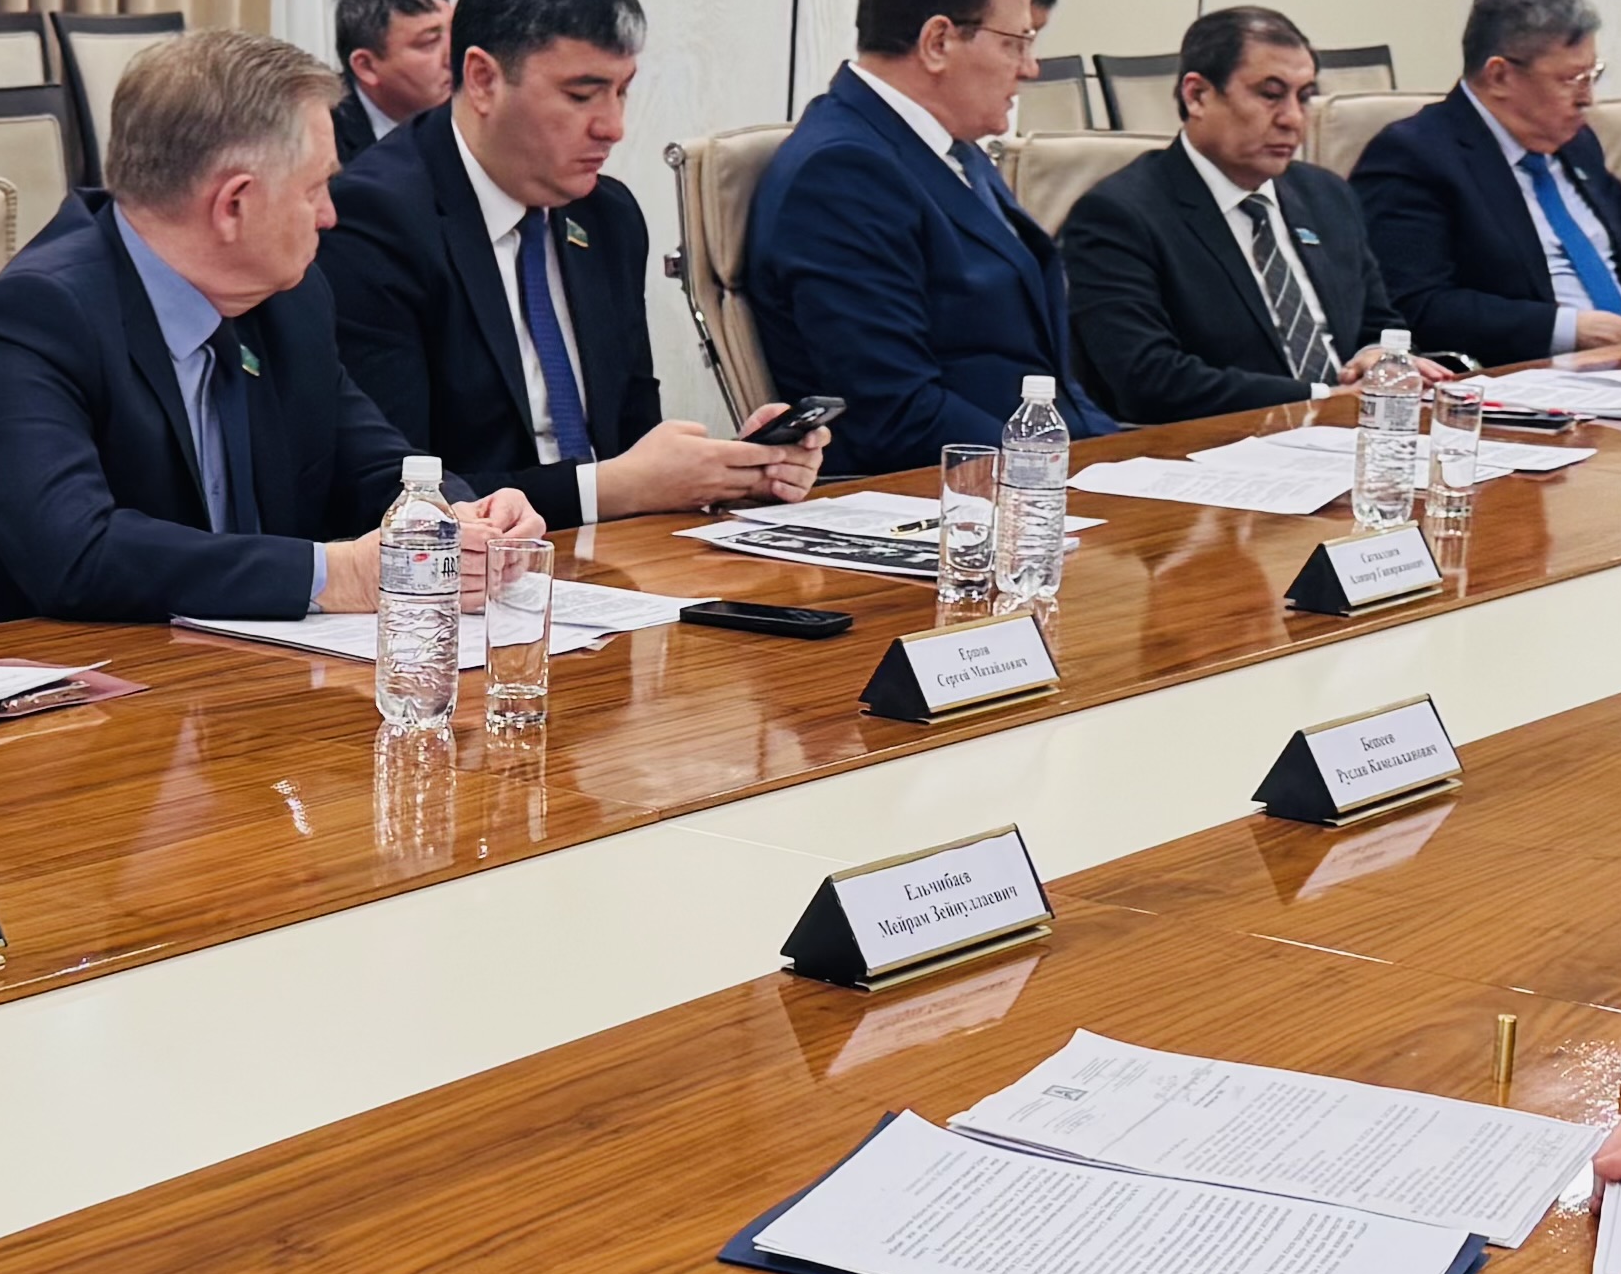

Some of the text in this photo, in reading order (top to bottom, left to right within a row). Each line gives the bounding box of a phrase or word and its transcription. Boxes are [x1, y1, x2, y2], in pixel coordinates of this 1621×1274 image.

[937, 668, 971, 688] Сергей
[903, 871, 973, 901] Ельчибаев
[877, 885, 1019, 939] Мейрам Зейнуллаевич
